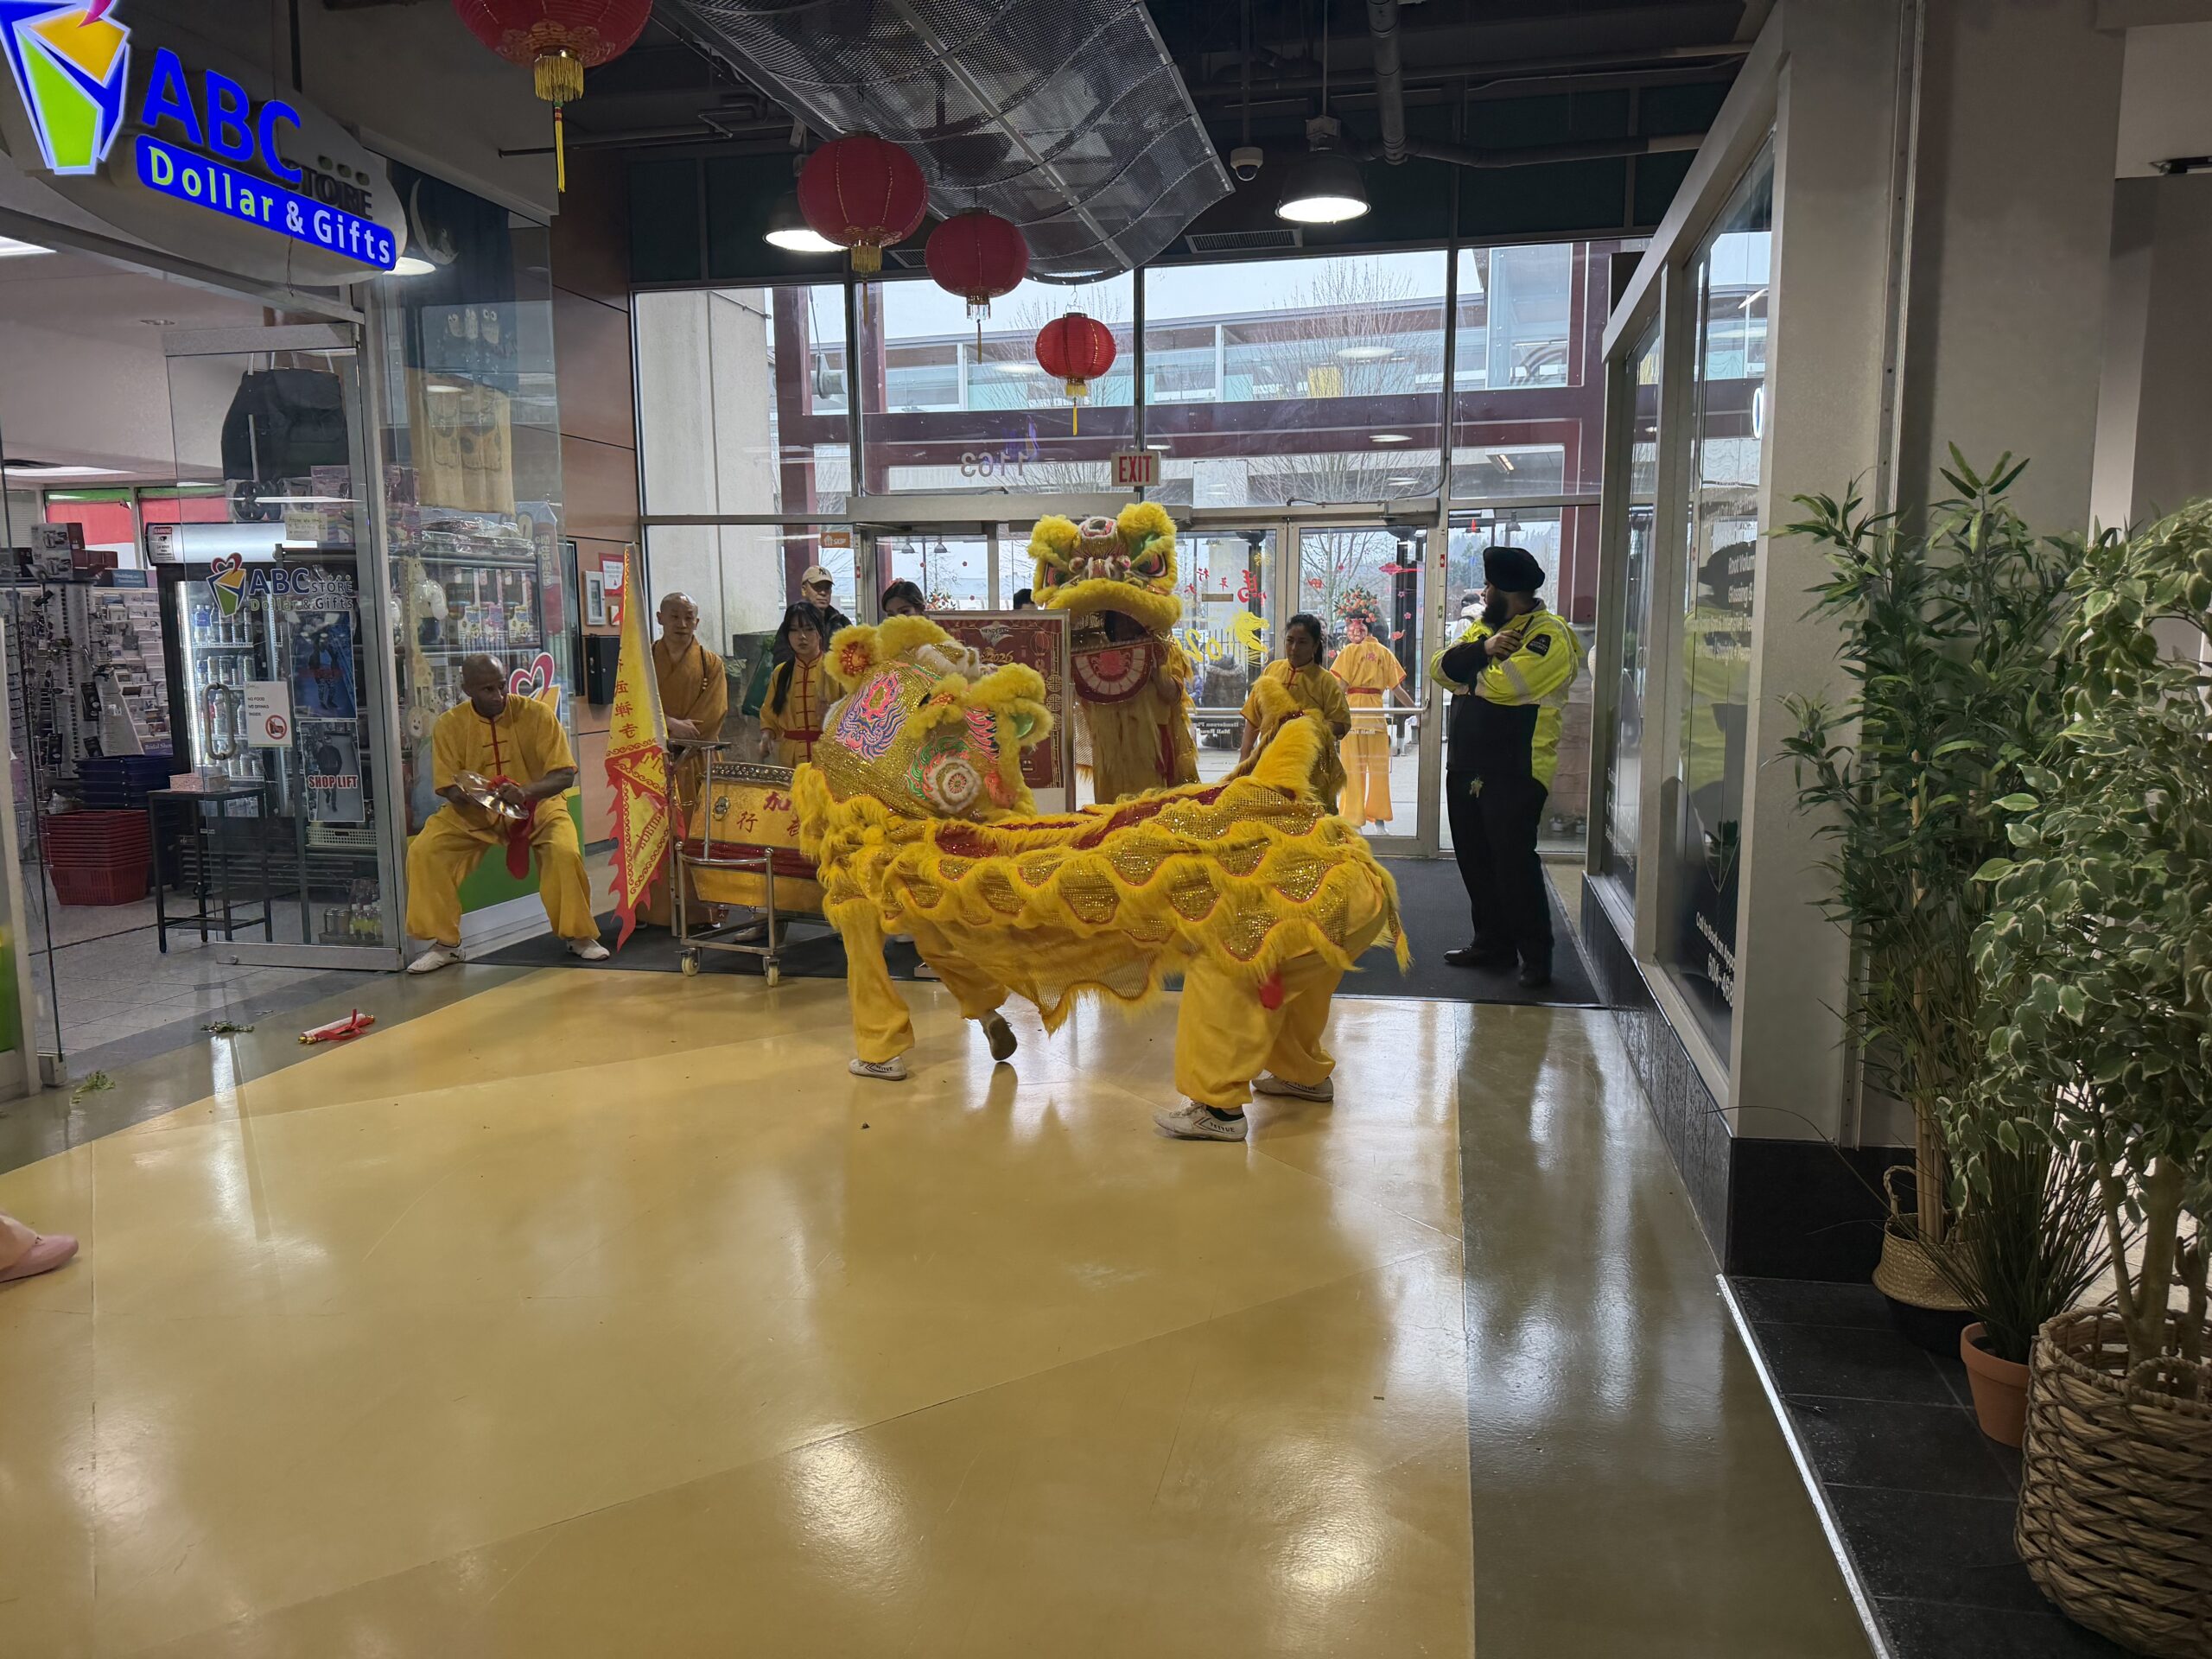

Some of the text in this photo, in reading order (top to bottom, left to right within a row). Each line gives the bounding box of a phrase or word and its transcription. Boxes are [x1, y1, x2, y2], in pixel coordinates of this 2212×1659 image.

[142, 47, 302, 182] ABC
[148, 146, 391, 264] Dollar & Gifts
[1119, 455, 1152, 483] EXIT
[249, 568, 353, 595] ABC STORE
[250, 597, 353, 612] Dollar & Gifts
[988, 650, 1014, 664] 2026
[308, 775, 358, 789] SHOP LIFT
[1708, 952, 1733, 1007] 604-468
